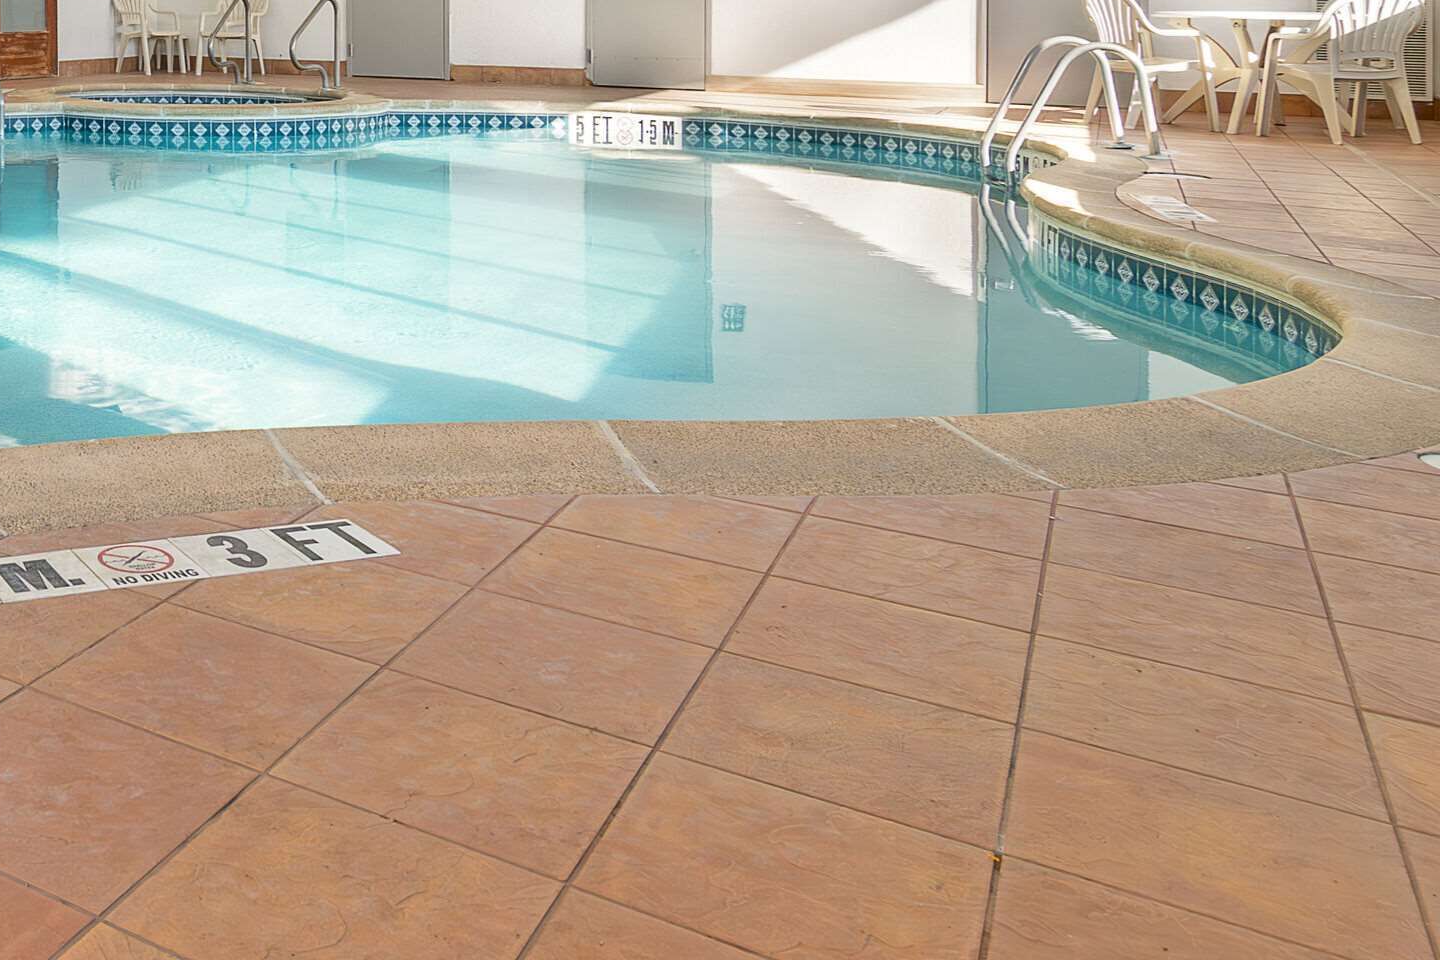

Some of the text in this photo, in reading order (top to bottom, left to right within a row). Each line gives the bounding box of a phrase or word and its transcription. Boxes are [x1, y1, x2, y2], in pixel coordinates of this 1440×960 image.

[206, 535, 268, 569] 3
[269, 521, 378, 561] FT
[112, 568, 200, 586] NO DIVING
